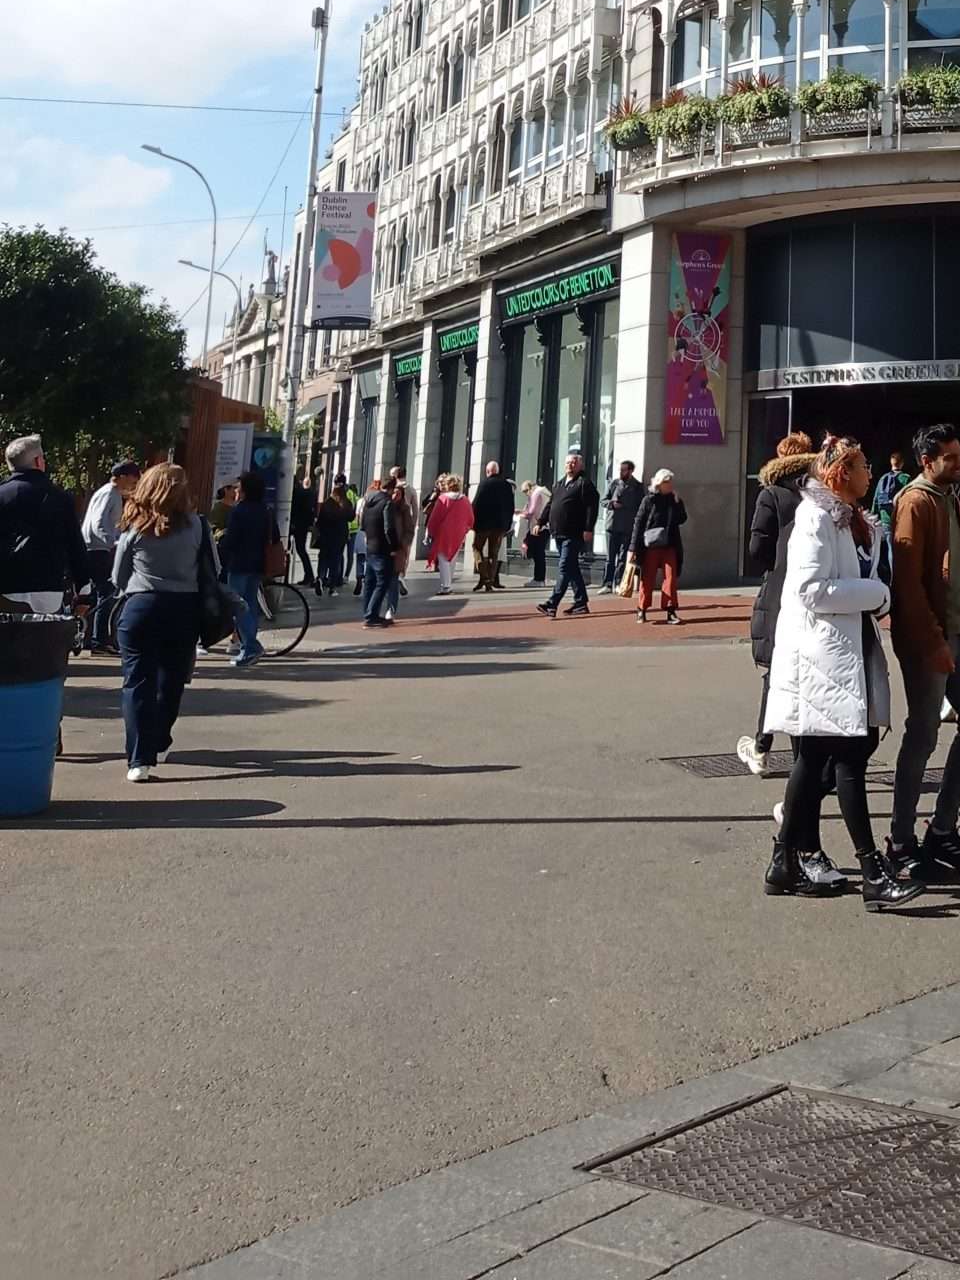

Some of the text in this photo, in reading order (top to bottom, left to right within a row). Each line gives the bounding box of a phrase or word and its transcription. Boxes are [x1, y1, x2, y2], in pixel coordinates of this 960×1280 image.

[321, 196, 348, 204] Dublin
[321, 204, 347, 212] Dance
[321, 211, 352, 219] Festival
[505, 291, 531, 317] UNITED
[530, 282, 560, 310] COLORS
[560, 278, 570, 301] OF
[440, 331, 459, 352] UNITED
[878, 363, 940, 381] GREEN
